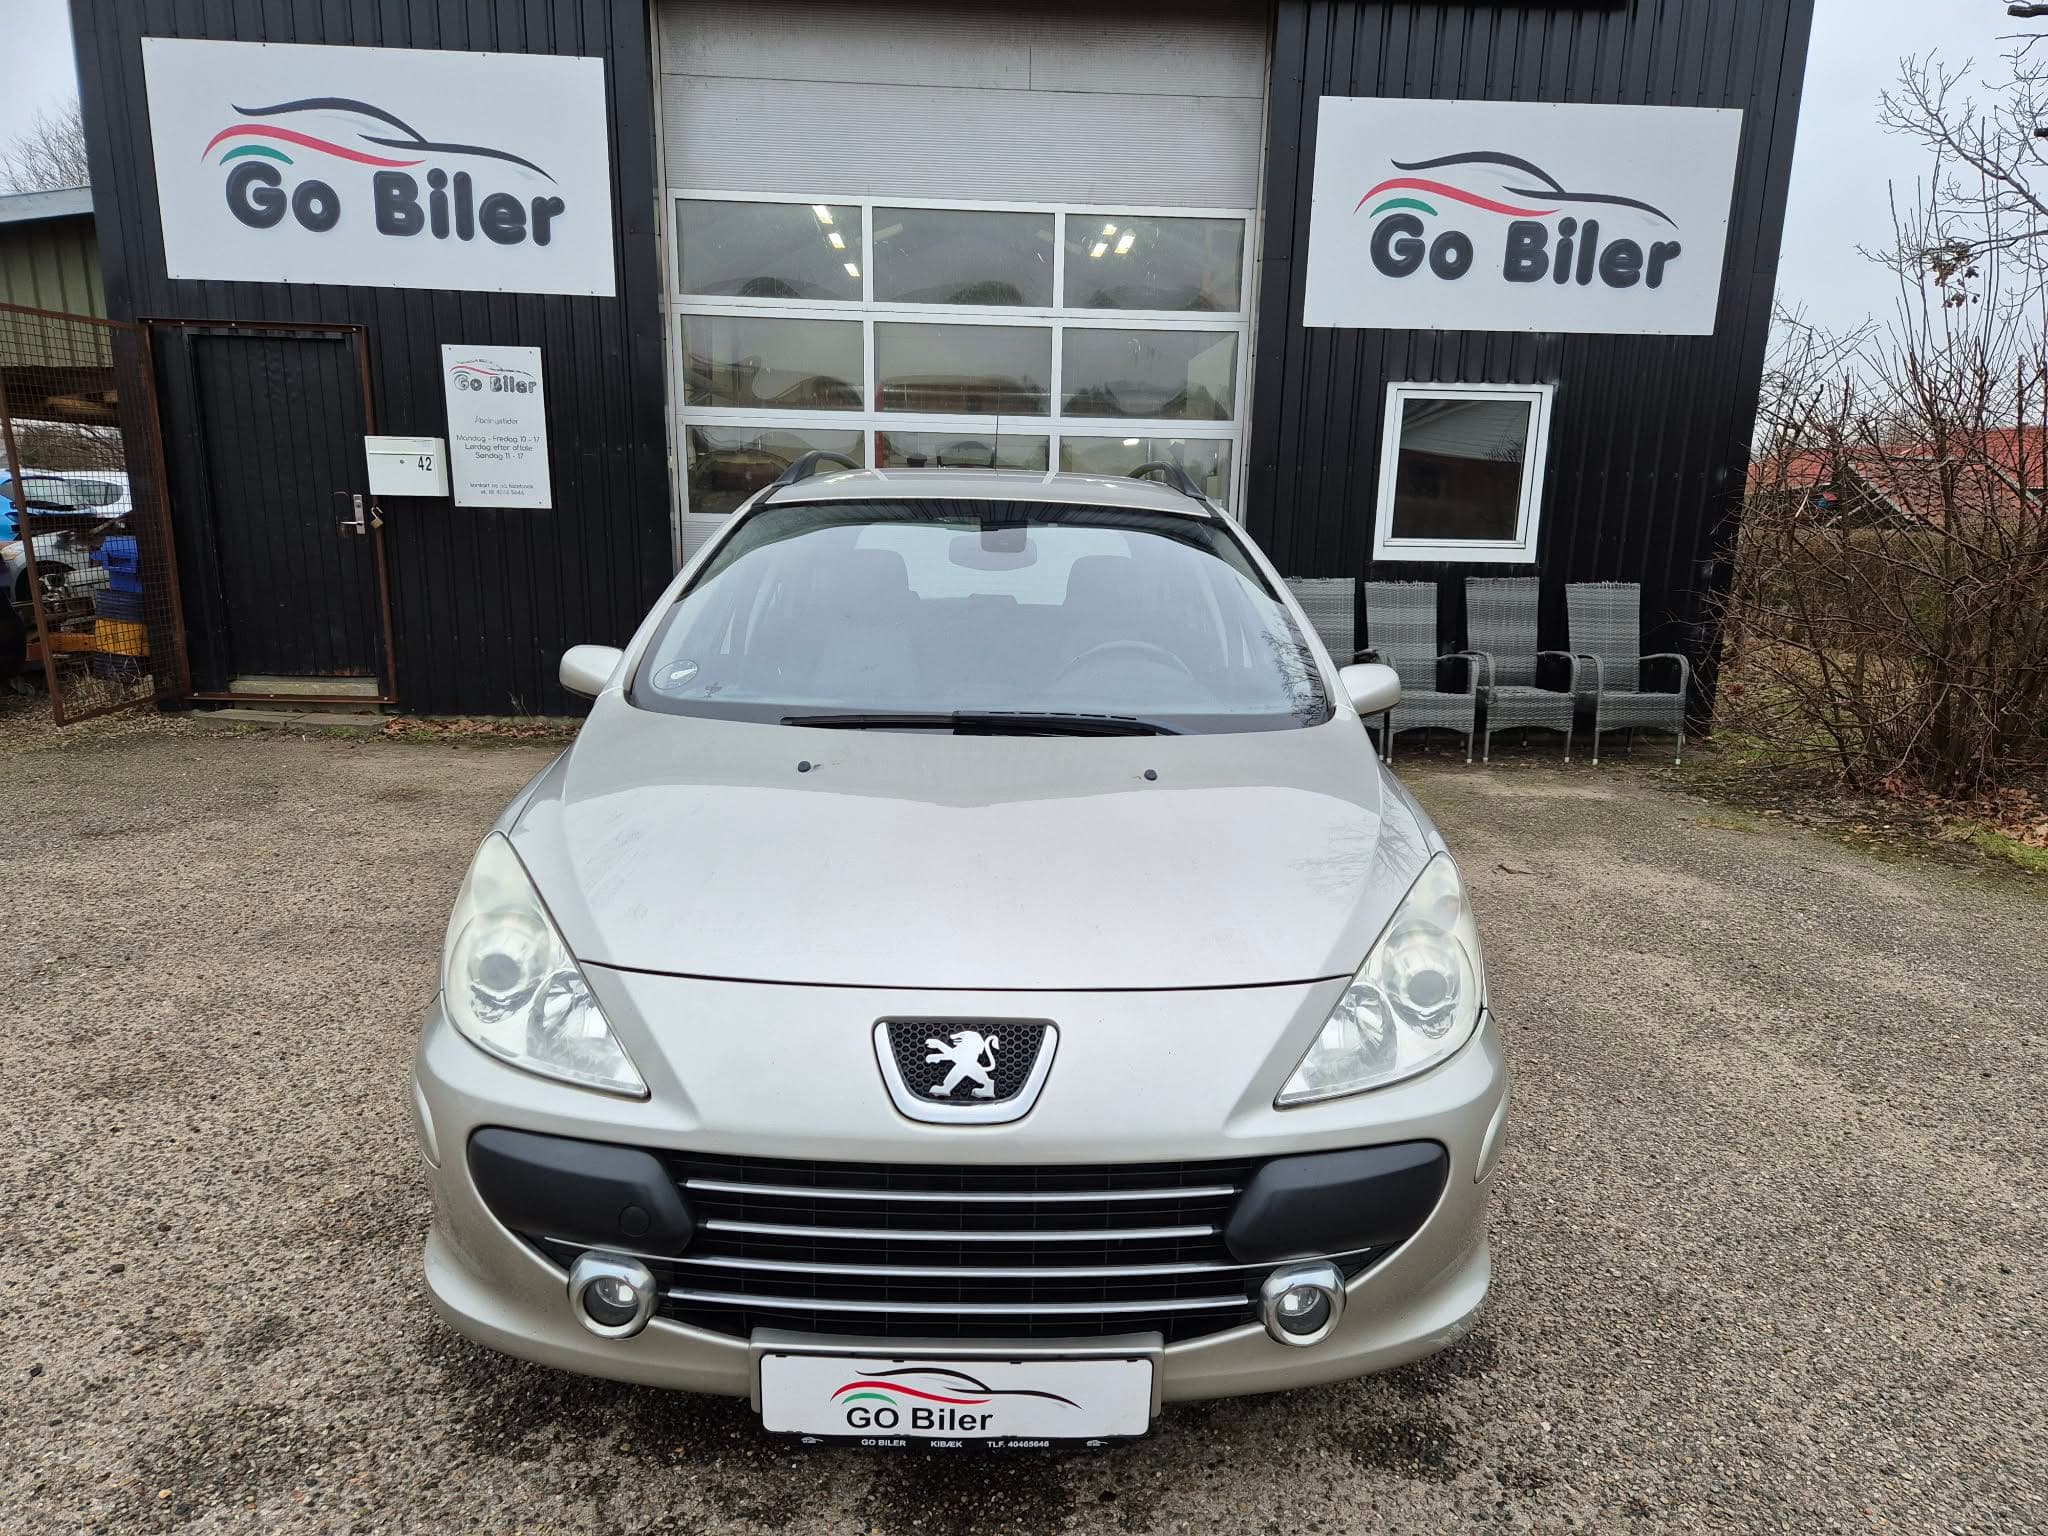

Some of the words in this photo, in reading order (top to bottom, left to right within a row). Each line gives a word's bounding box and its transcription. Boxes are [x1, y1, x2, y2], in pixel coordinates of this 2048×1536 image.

[226, 161, 341, 232] Go
[373, 168, 566, 246] Biler
[1370, 213, 1474, 281] Go
[1503, 217, 1682, 289] Biler
[453, 374, 483, 391] Go
[490, 375, 537, 393] Biler
[417, 456, 432, 471] 42
[846, 1407, 899, 1429] GO
[911, 1407, 994, 1431] Biler
[861, 1439, 876, 1447] GO
[878, 1439, 907, 1448] BILER
[930, 1440, 963, 1448] KIBÆK
[986, 1440, 1006, 1448] TLF.
